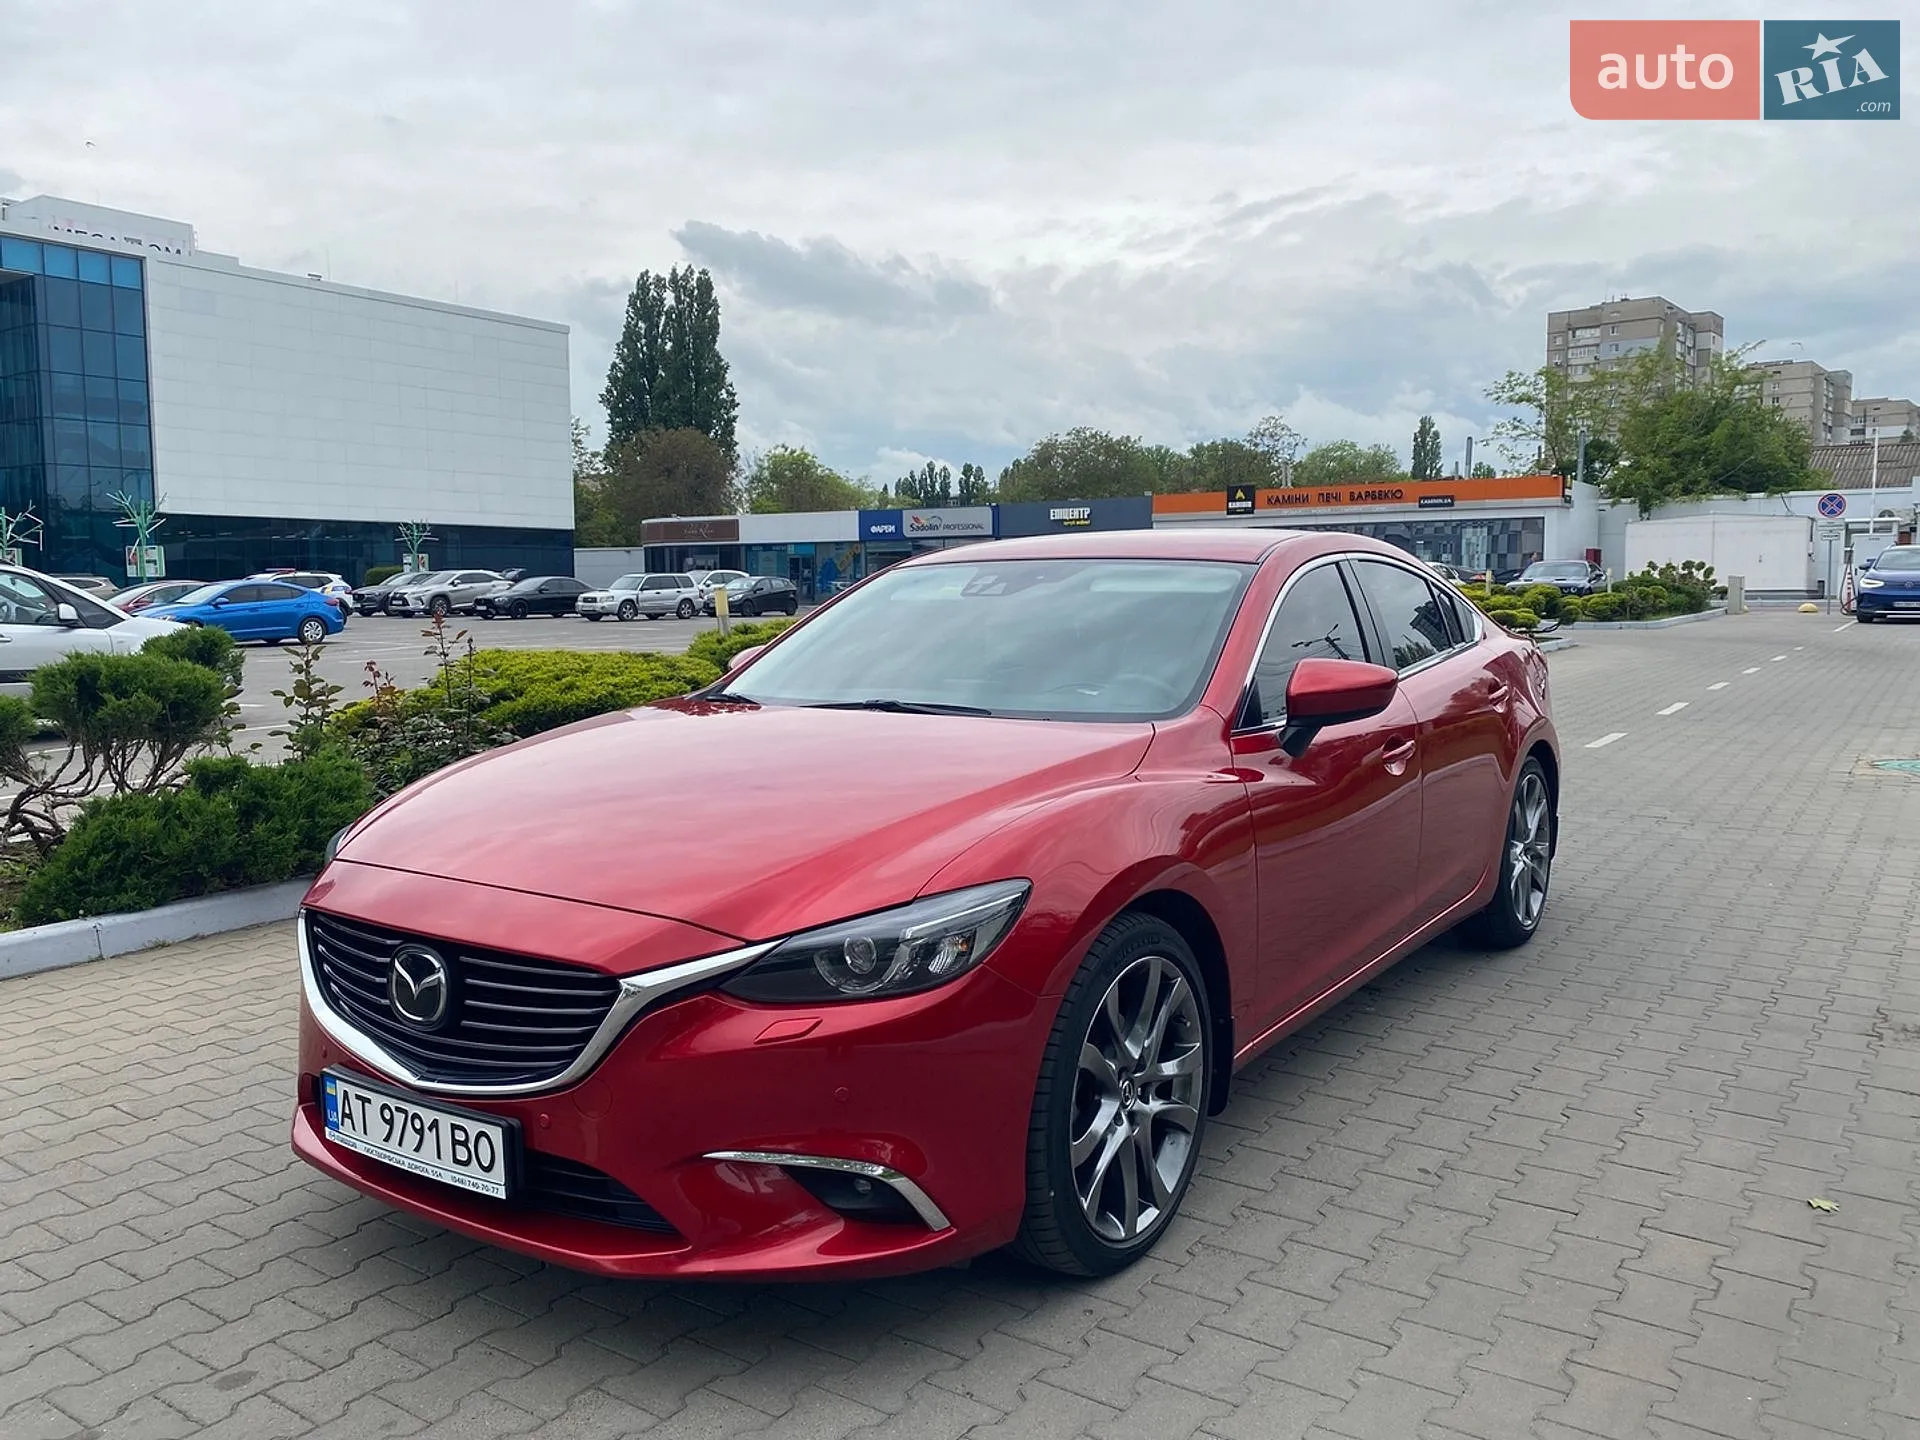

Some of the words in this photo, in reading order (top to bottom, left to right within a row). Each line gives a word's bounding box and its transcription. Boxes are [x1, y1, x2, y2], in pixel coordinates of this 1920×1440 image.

[1266, 493, 1309, 505] КАМІНИ
[1317, 491, 1342, 503] ПЕЧІ
[1349, 488, 1404, 501] БАРБЕКЮ
[870, 524, 896, 534] ФАРБИ
[909, 522, 940, 532] Sadolin
[942, 522, 985, 531] PROFESSIONAL
[327, 1109, 339, 1122] UA
[340, 1089, 372, 1136] AT
[379, 1102, 443, 1161] 9791
[450, 1122, 496, 1173] BO
